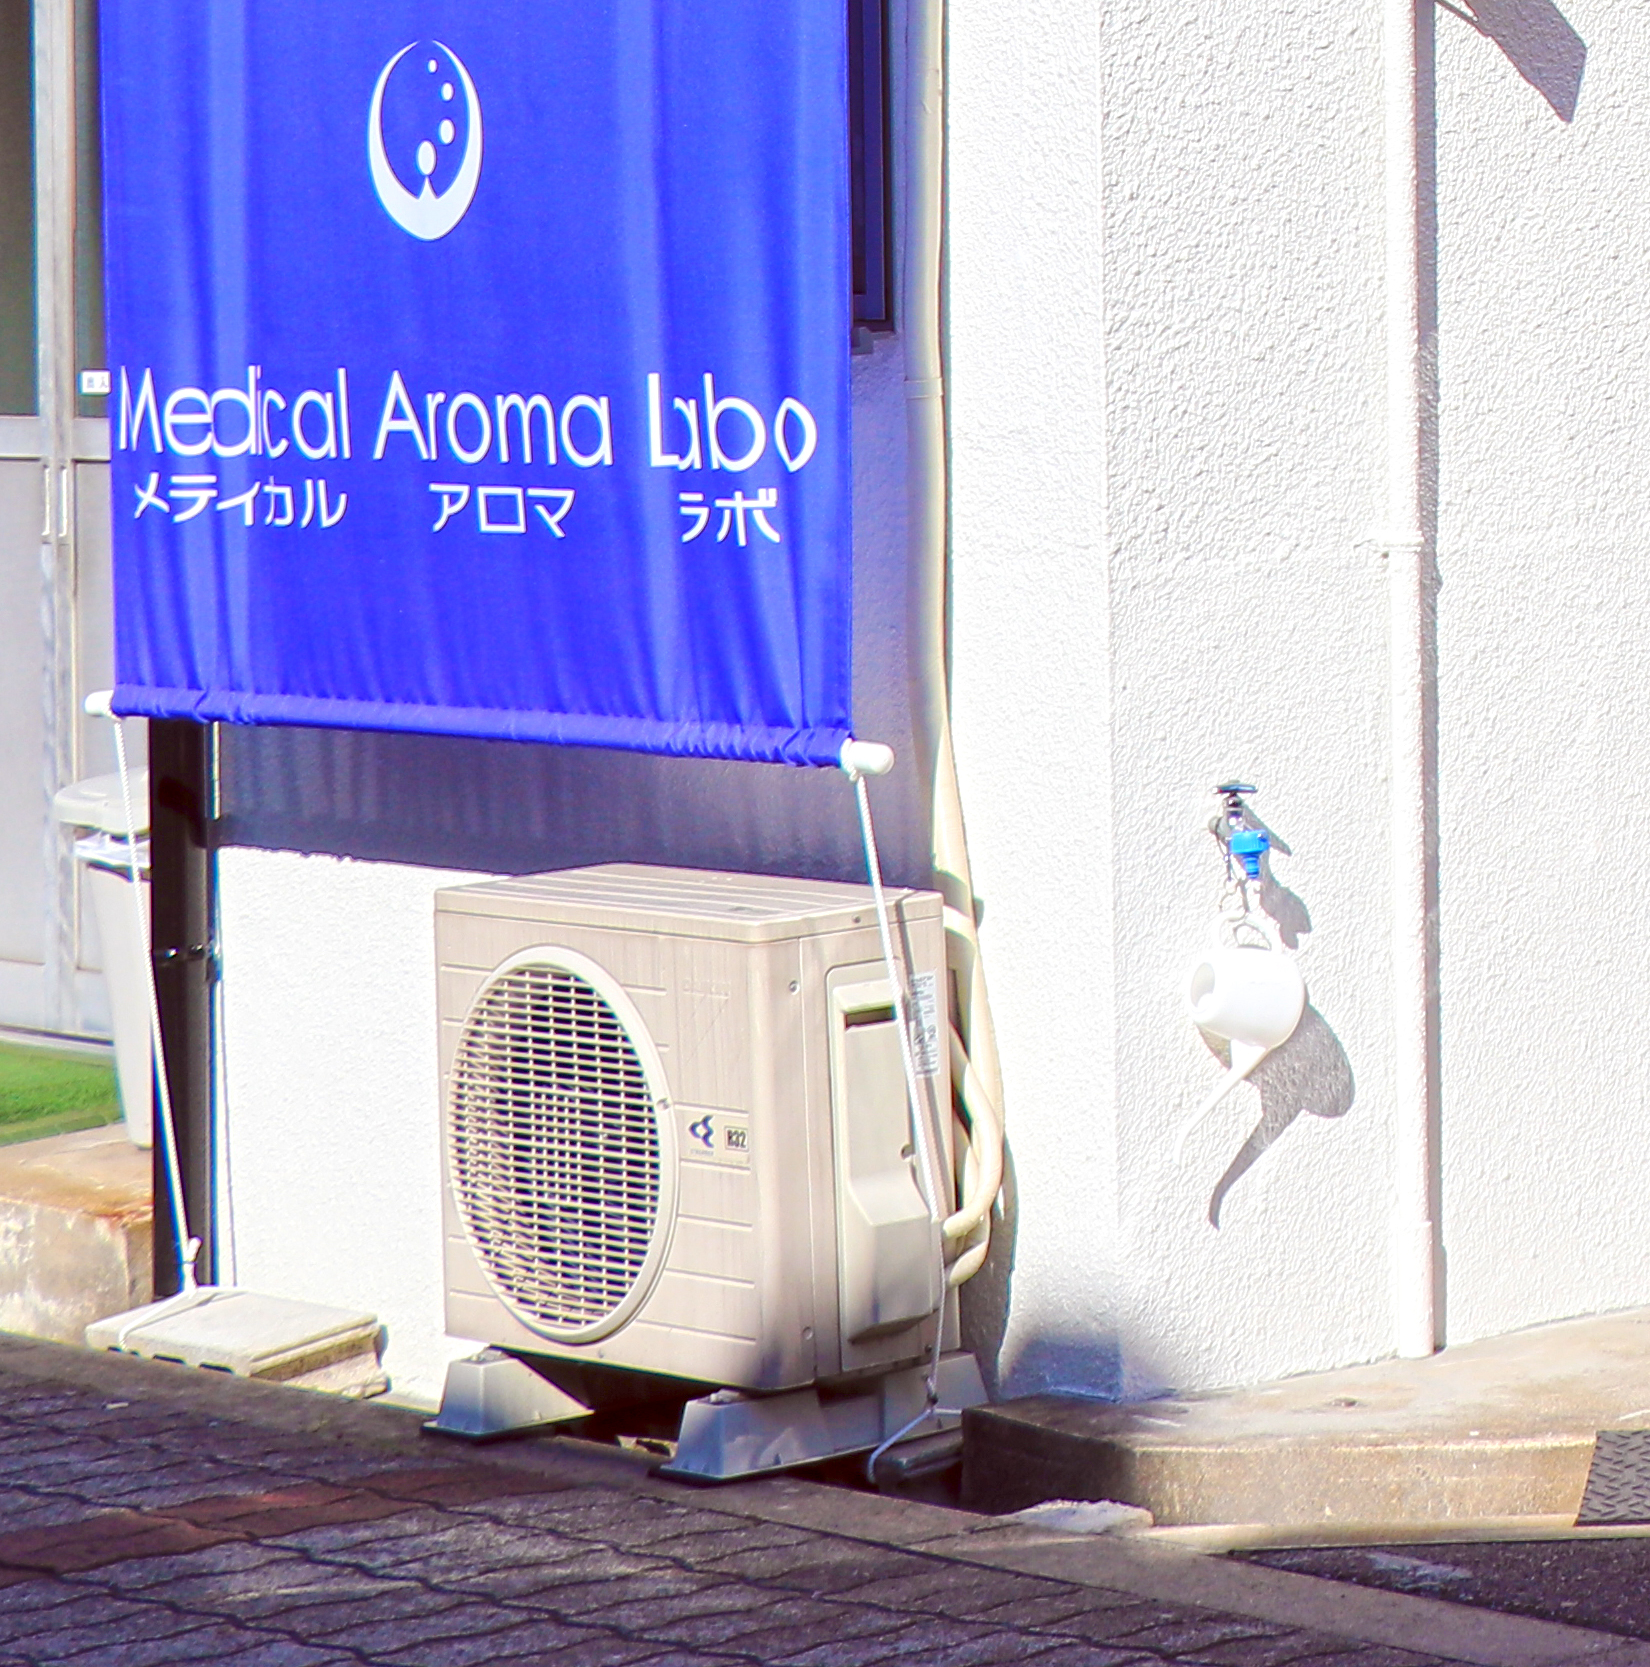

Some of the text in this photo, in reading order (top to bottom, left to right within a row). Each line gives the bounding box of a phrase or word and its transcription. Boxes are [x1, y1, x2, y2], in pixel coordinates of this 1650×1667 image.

[119, 364, 351, 460] Medical
[373, 369, 615, 469] Aroma
[428, 482, 576, 539] アロマ
[679, 488, 783, 547] ラボ
